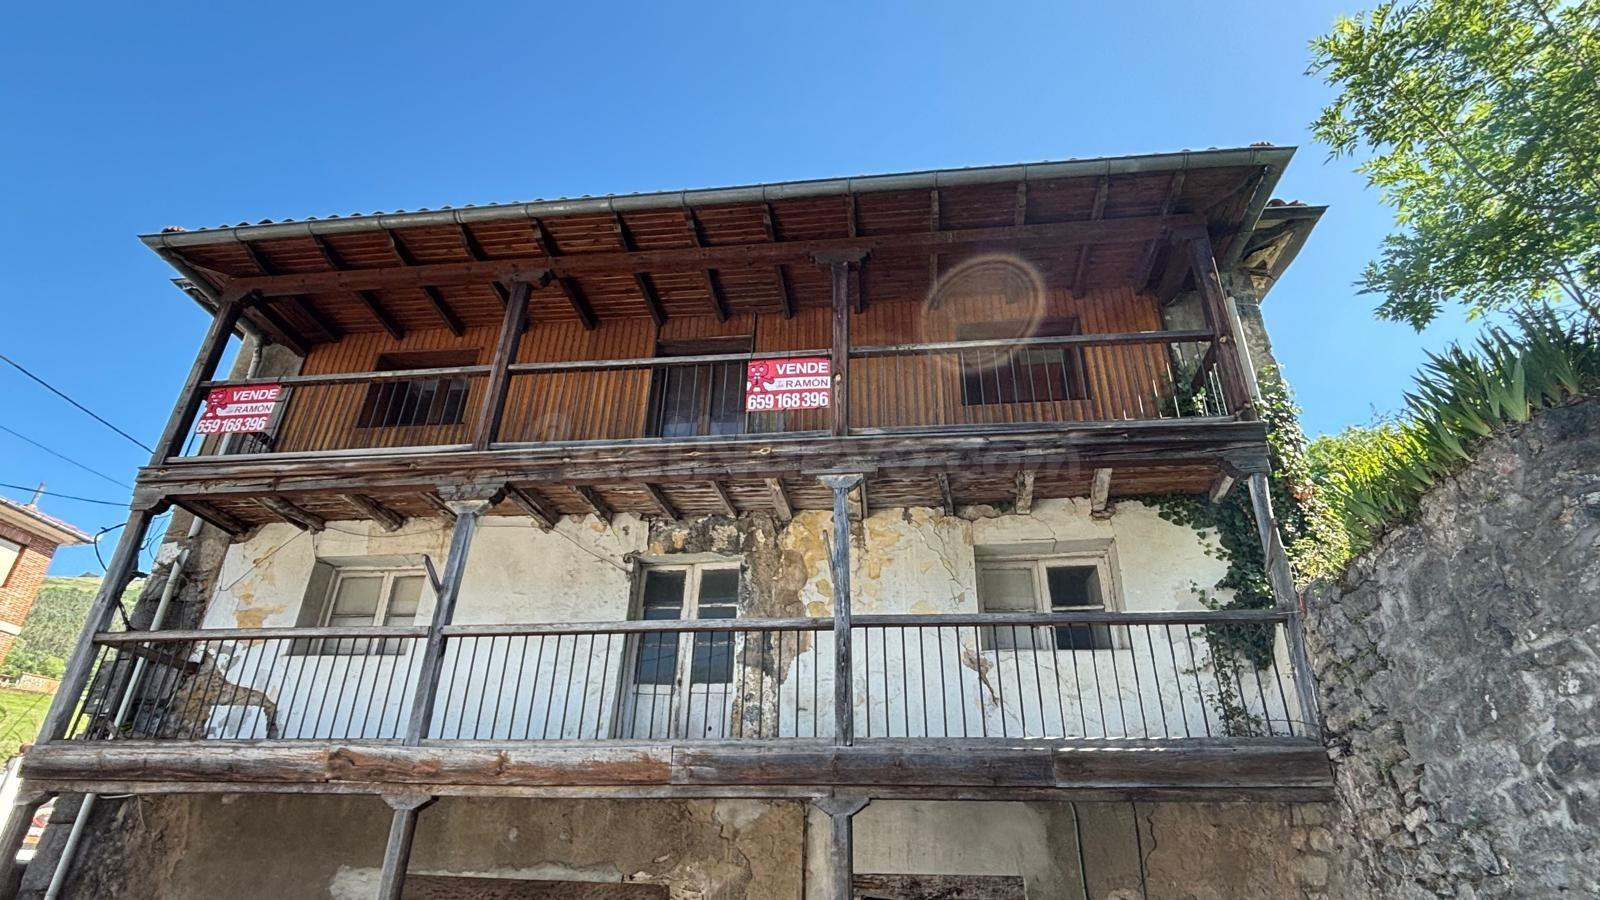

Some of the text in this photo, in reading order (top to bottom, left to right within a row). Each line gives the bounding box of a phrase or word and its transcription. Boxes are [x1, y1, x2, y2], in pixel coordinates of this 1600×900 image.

[776, 362, 829, 375] VENDE
[785, 378, 828, 388] RAMÓN
[233, 389, 278, 401] VENDE
[748, 391, 829, 410] 659 168 396
[196, 417, 267, 433] 659 168 396
